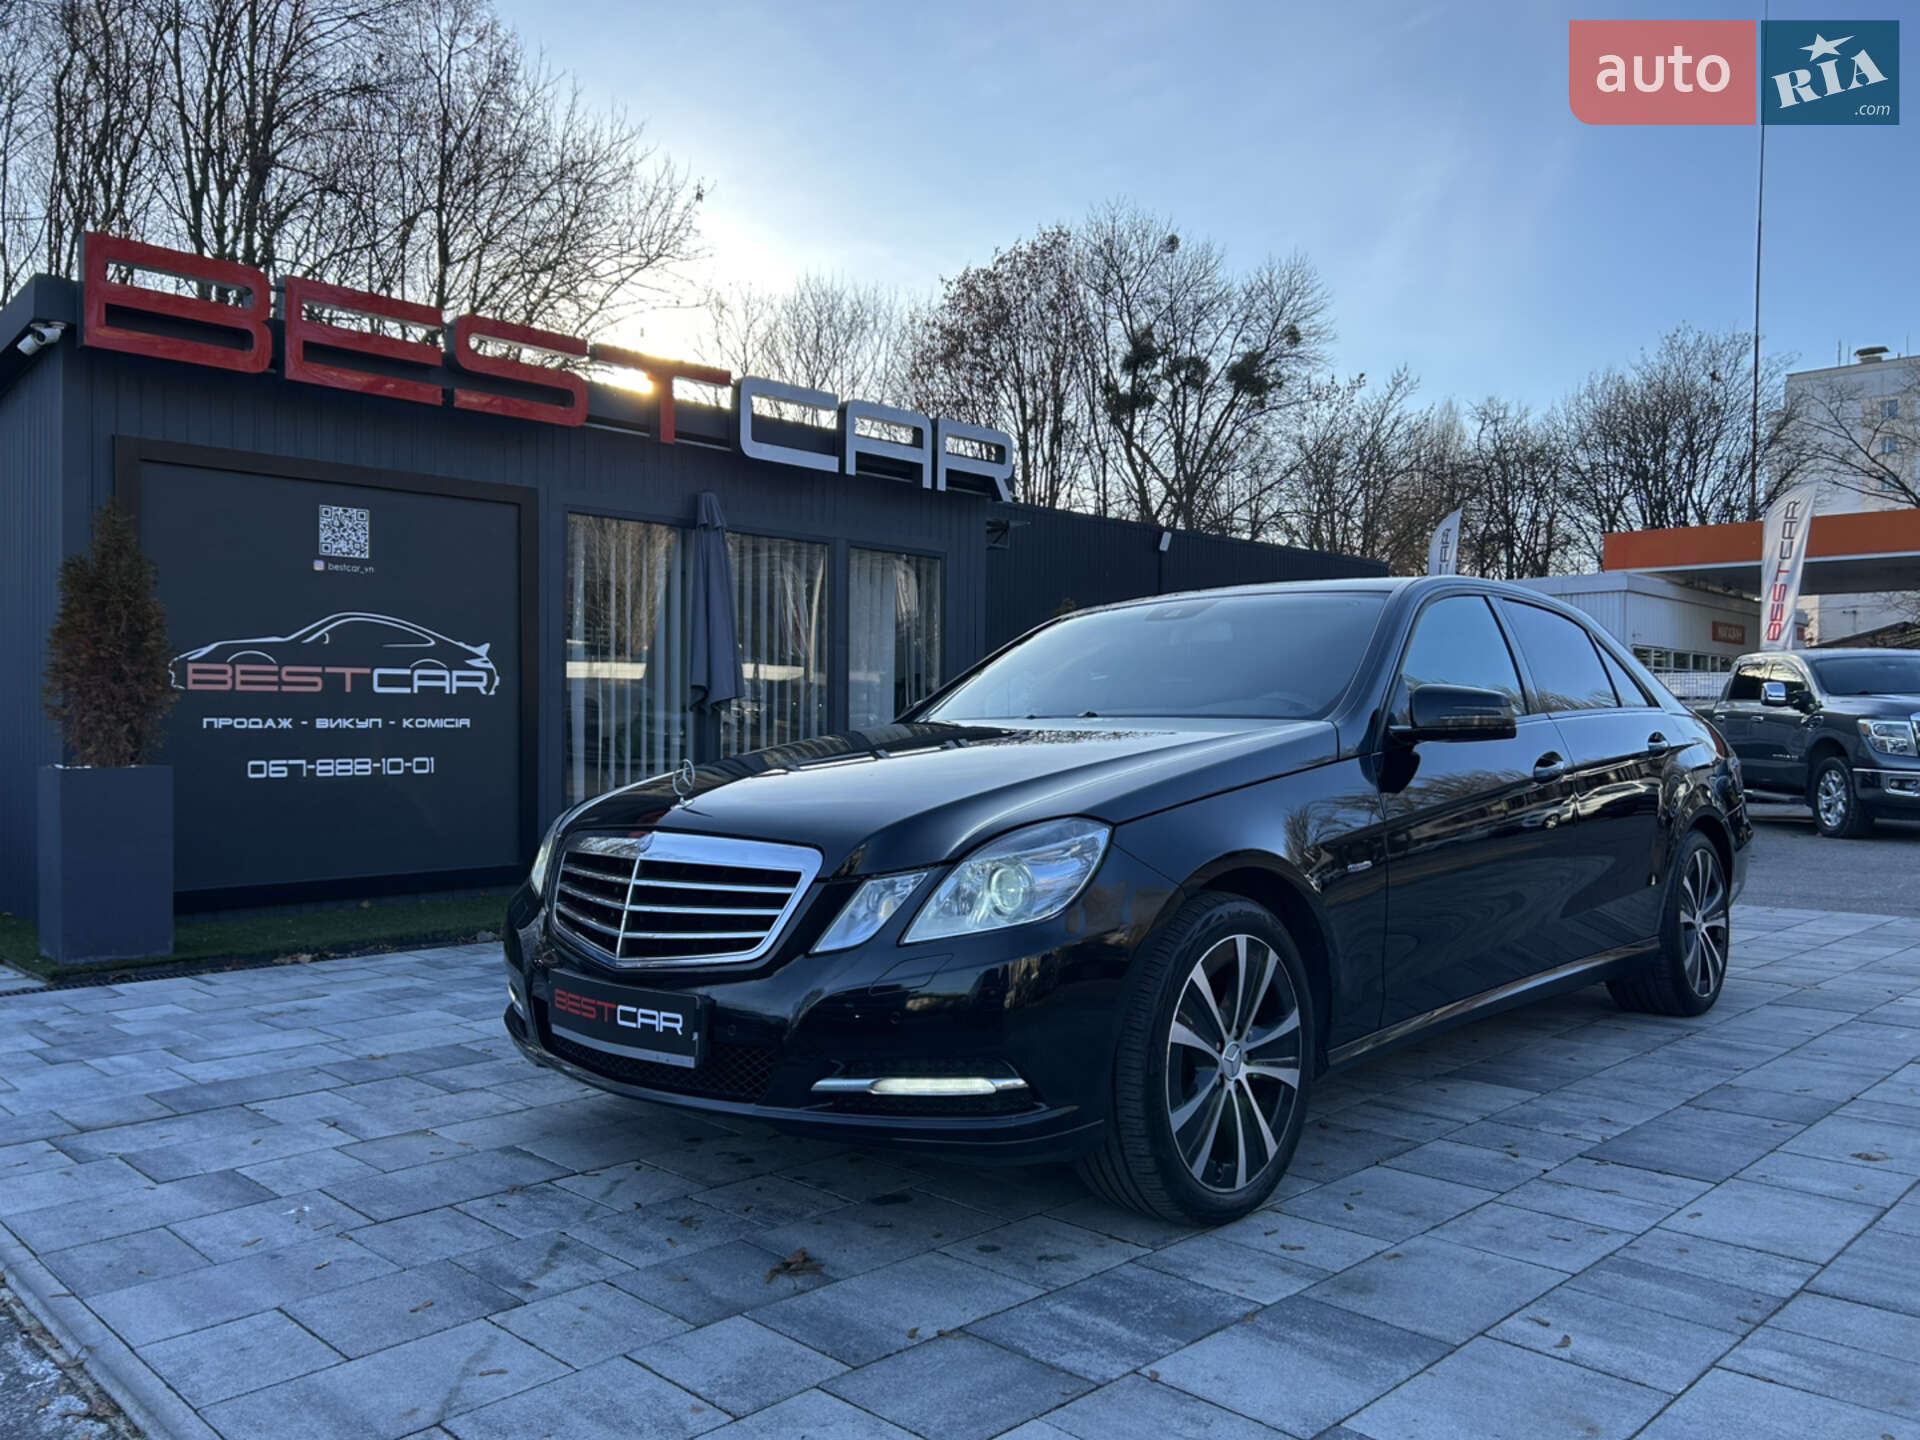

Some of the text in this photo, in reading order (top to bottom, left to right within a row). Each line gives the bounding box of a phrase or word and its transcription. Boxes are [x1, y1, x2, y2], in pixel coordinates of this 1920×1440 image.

[202, 717, 293, 729] ПРОДАЖ
[315, 717, 383, 729] ВИКУП
[402, 717, 471, 729] КОМІСІЯ
[247, 756, 435, 778] 067-888-10-01
